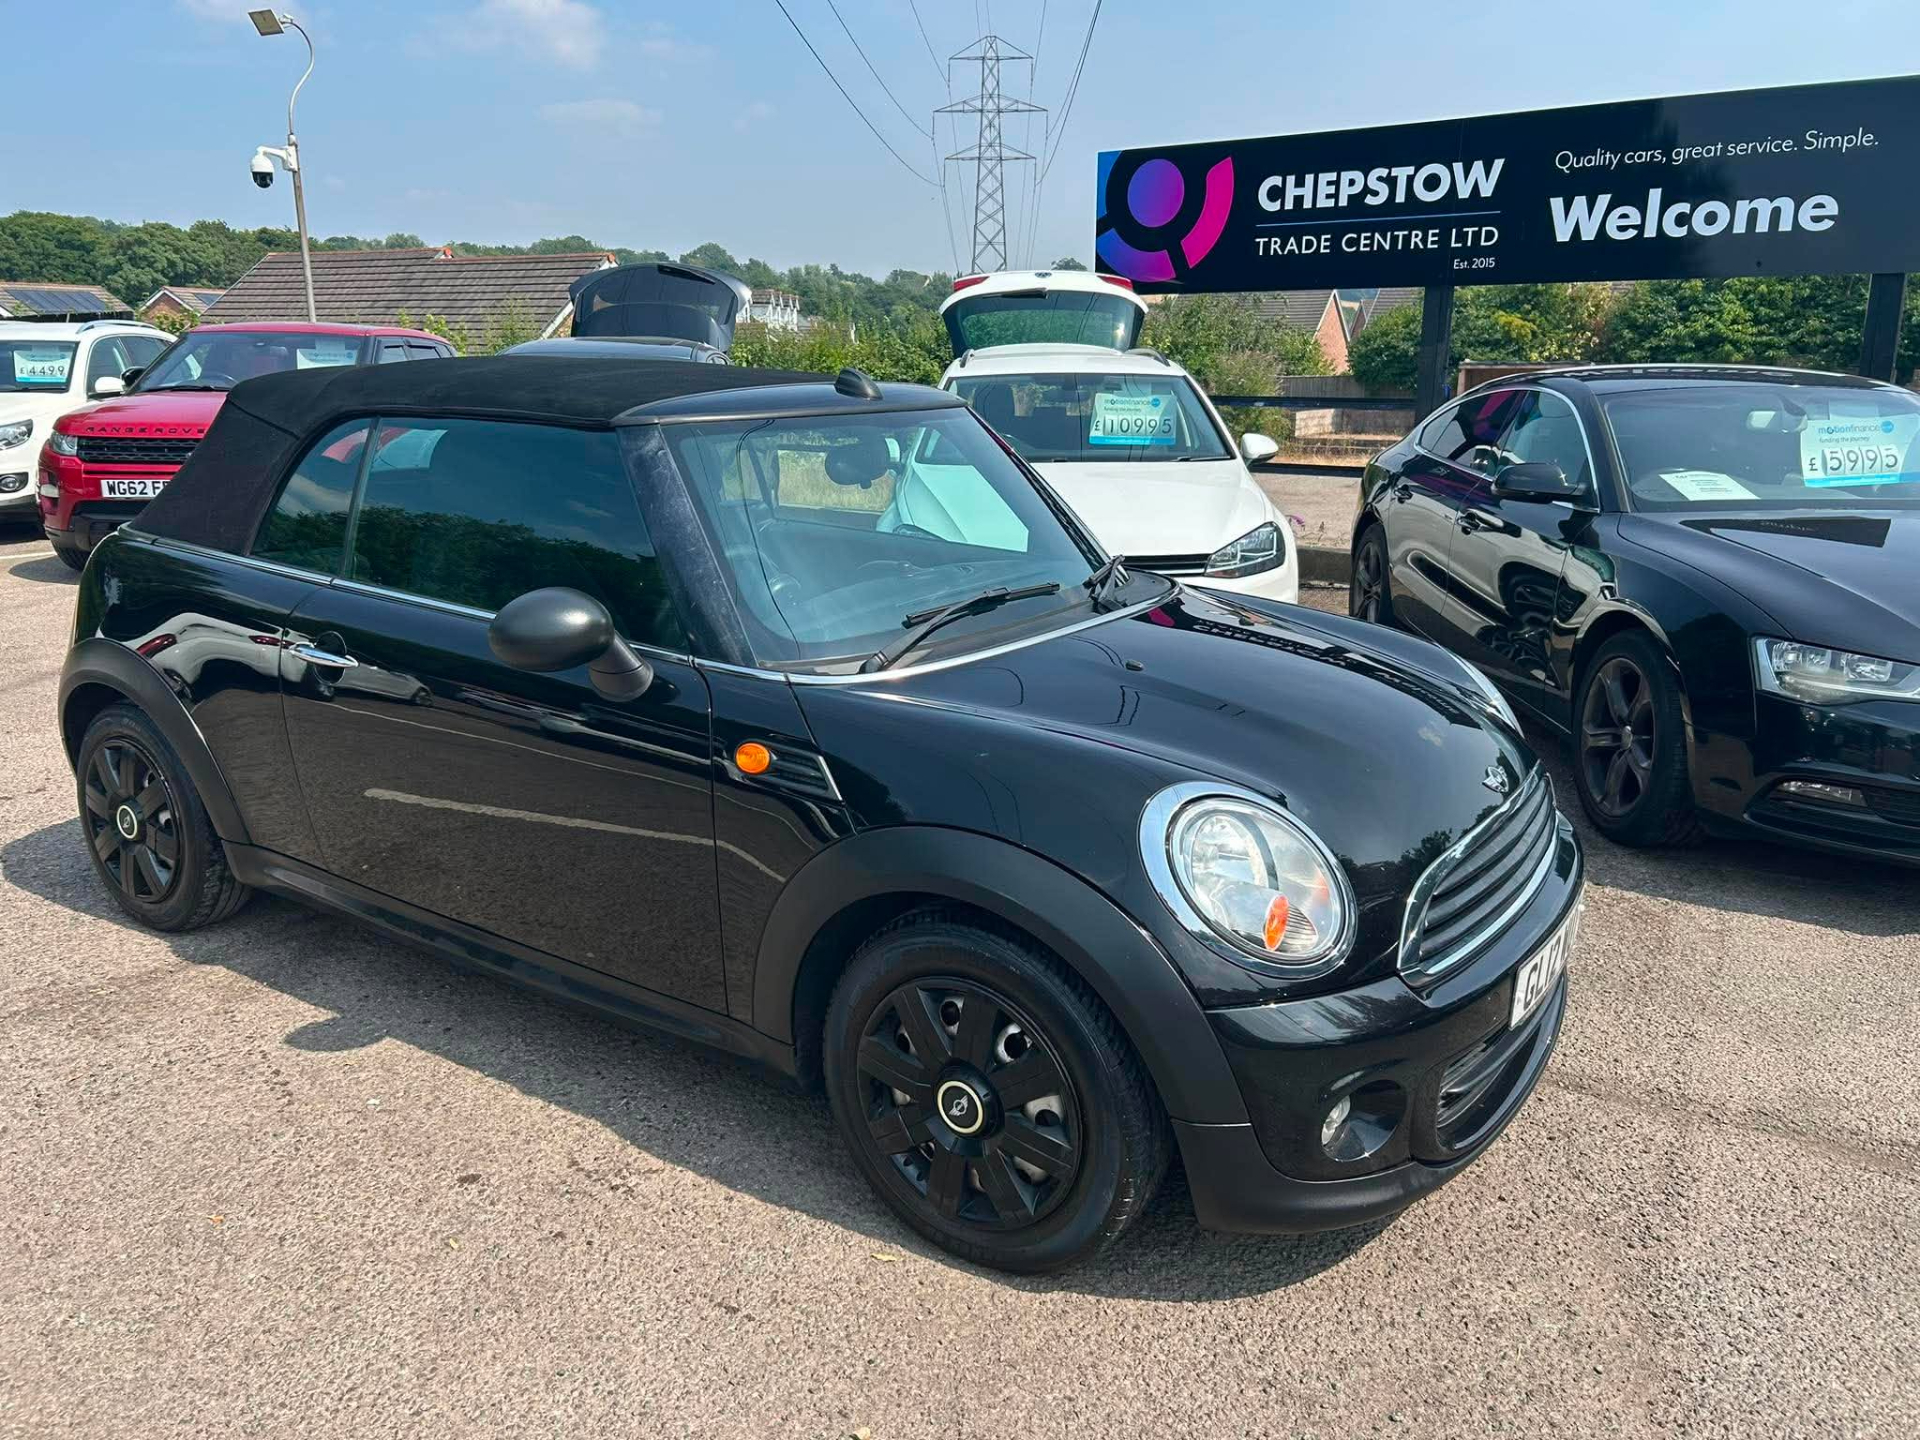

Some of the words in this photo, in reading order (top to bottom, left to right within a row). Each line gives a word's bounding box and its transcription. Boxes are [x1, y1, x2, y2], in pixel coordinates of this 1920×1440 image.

[1555, 147, 1621, 173] Quality
[1624, 148, 1667, 164] cars,
[1672, 141, 1724, 165] great
[1727, 135, 1798, 156] service.
[1804, 127, 1879, 152] Simple.
[1258, 158, 1506, 212] CHEPSTOW
[1550, 187, 1839, 242] Welcome
[1255, 234, 1332, 256] TRADE
[1341, 229, 1440, 252] CENTRE
[1450, 226, 1499, 248] LTD
[1453, 258, 1470, 270] Est.
[1471, 257, 1496, 269] 2015
[86, 426, 147, 434] RANGE
[107, 480, 148, 495] WG62
